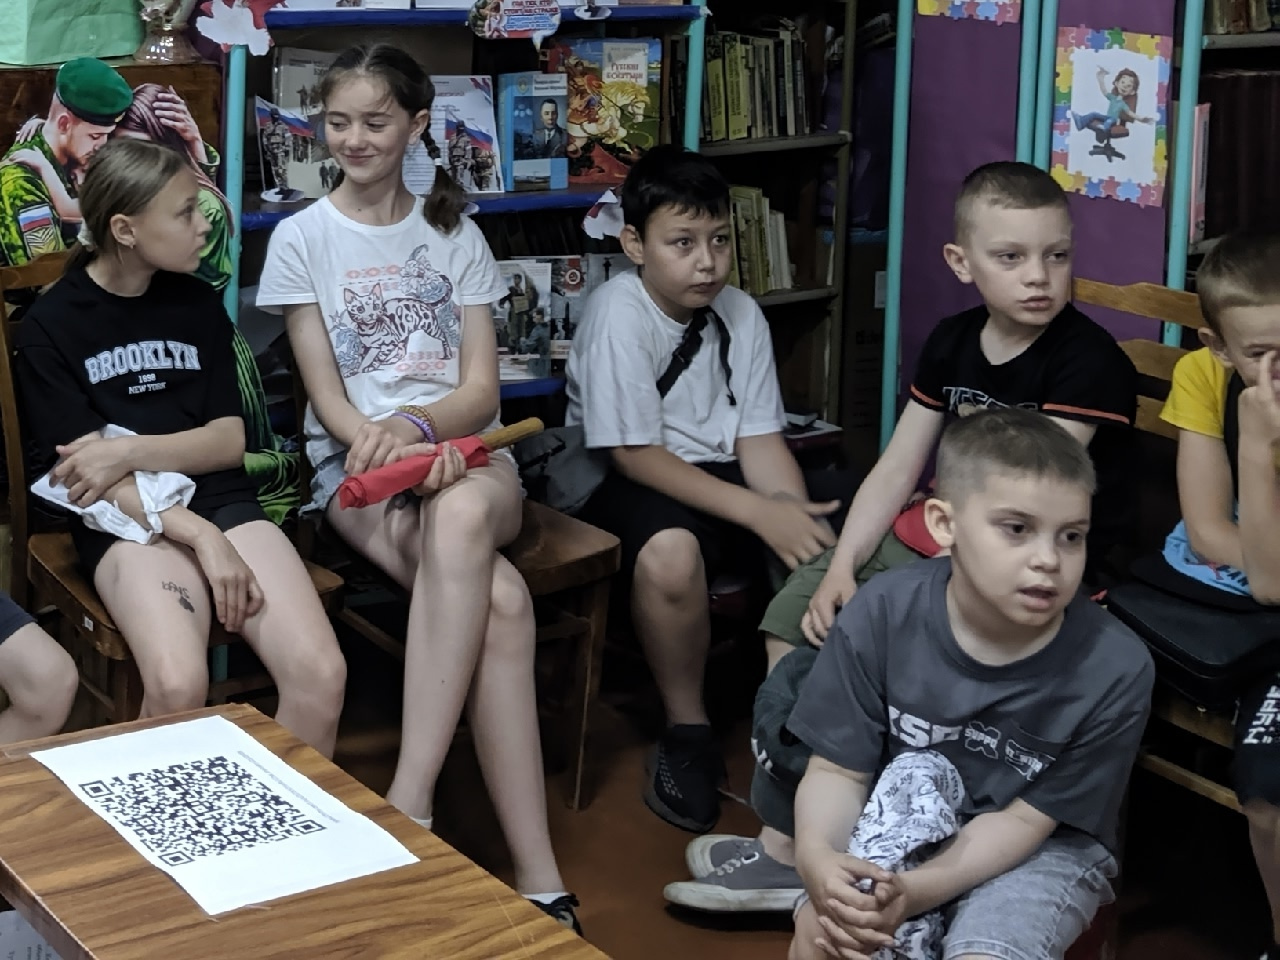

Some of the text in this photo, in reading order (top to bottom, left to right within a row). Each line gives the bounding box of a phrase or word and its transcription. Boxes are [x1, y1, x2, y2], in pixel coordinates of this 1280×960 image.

[85, 340, 201, 384] BROOKLYN
[128, 382, 166, 394] NEW YORK
